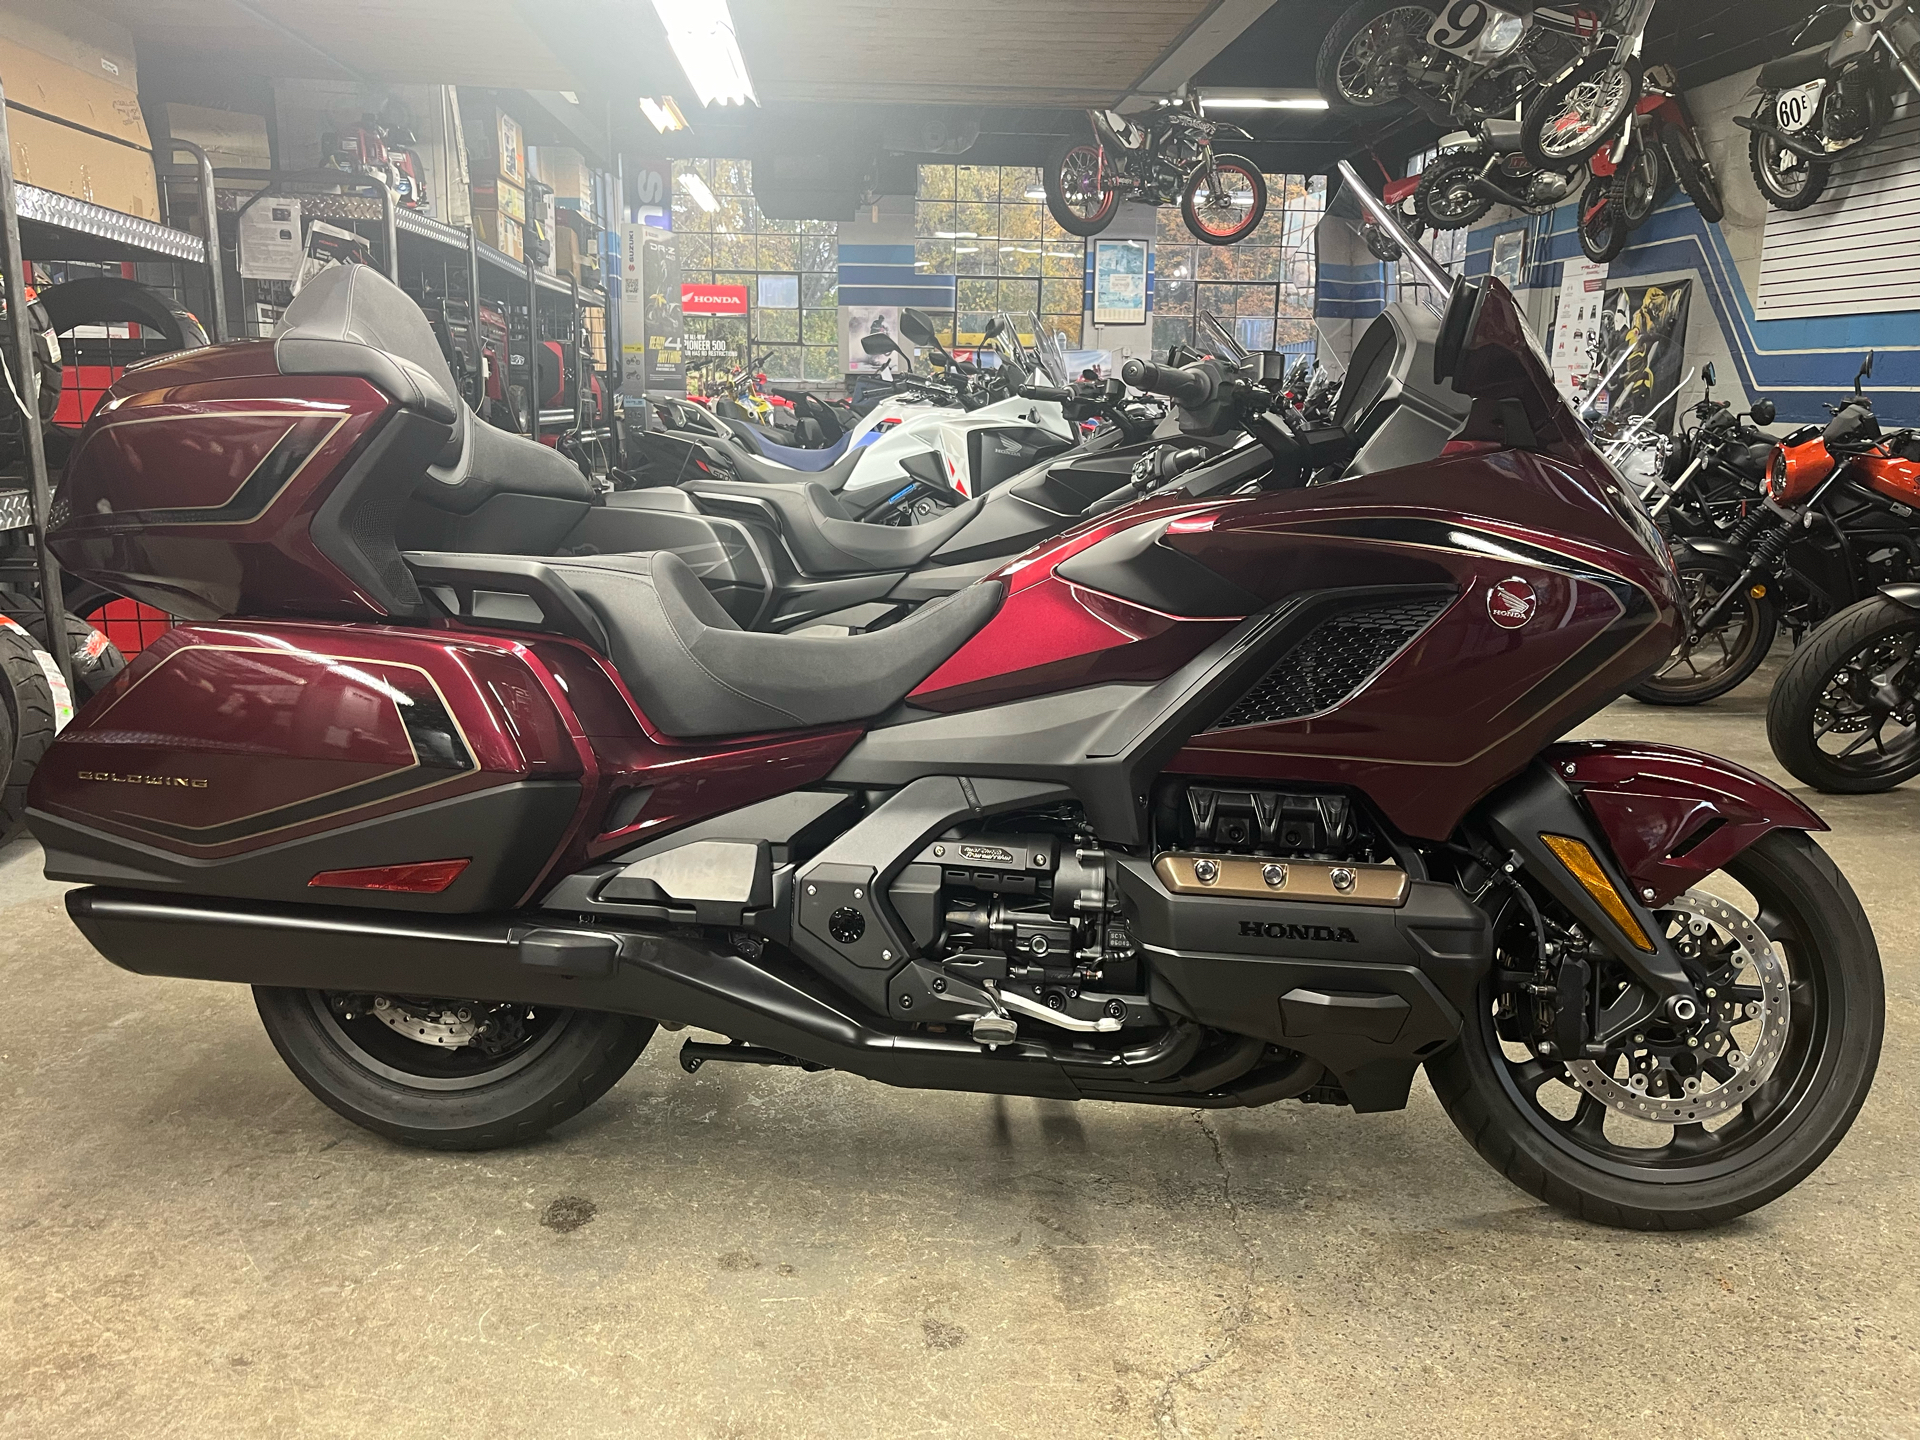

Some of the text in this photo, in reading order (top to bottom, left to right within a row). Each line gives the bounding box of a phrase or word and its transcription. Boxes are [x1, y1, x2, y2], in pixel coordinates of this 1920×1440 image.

[1433, 0, 1488, 48] 9
[693, 295, 741, 304] HONDA
[664, 336, 682, 351] 4
[711, 340, 726, 351] 500
[994, 448, 1021, 458] HONDA
[1493, 609, 1527, 620] HONDA
[77, 771, 208, 788] GOLDWING
[1238, 921, 1360, 943] HONDA
